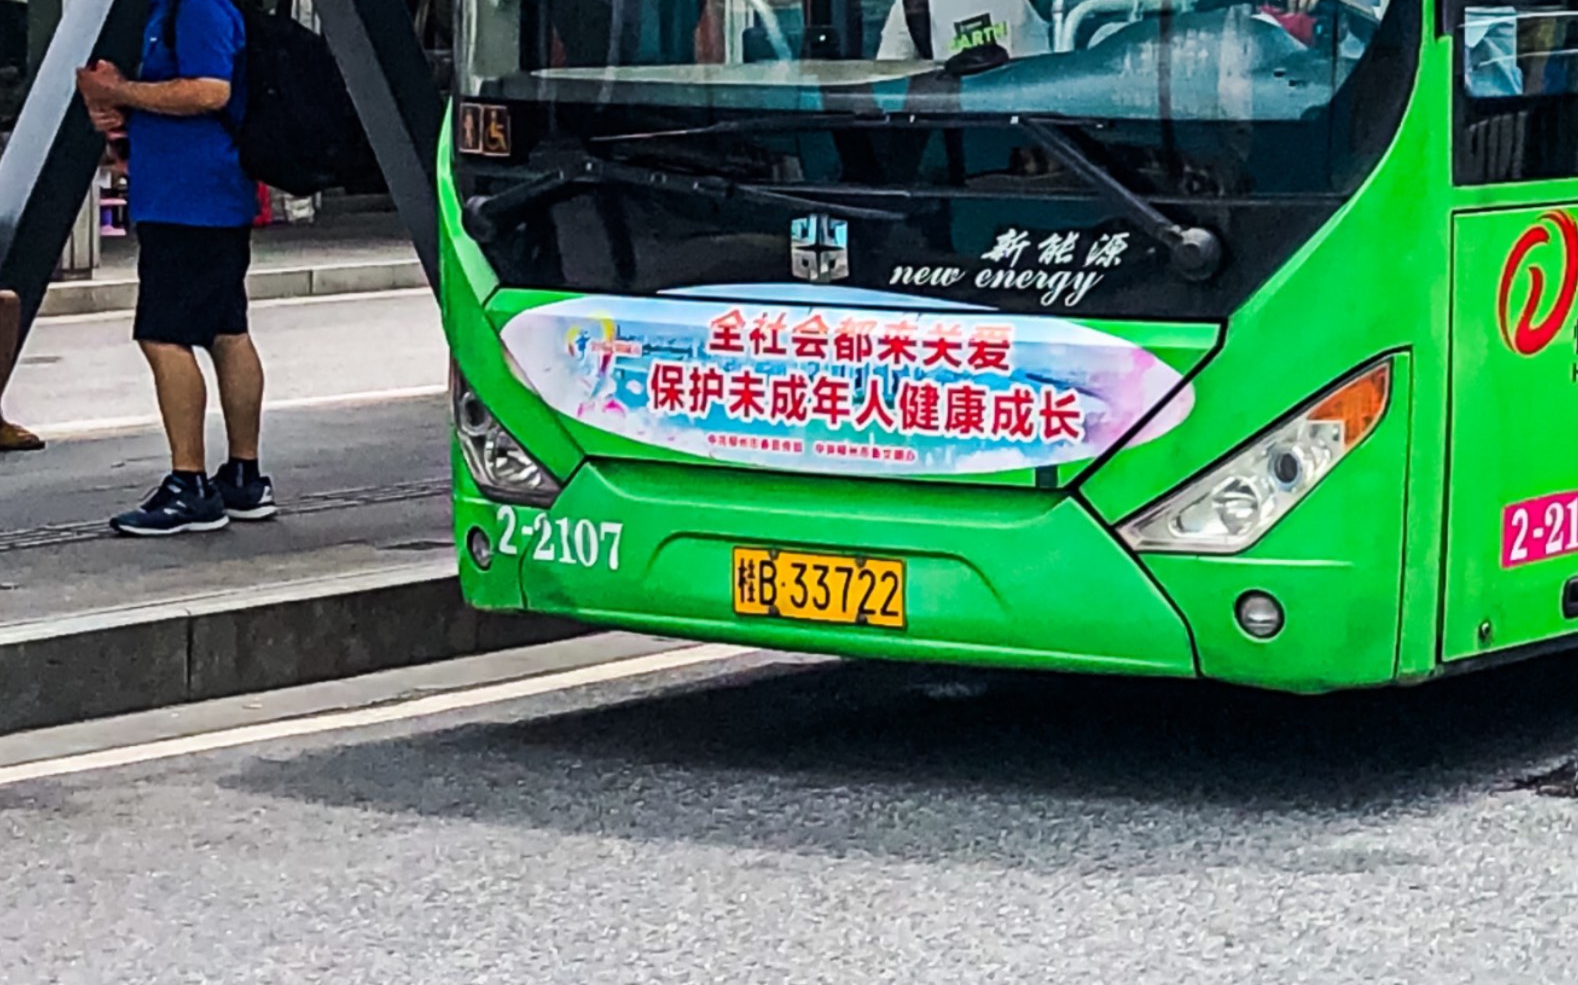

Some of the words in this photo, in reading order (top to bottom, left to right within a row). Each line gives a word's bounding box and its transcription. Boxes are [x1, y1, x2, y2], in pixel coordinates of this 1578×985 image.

[980, 228, 1131, 268] 新能源
[889, 265, 966, 287] new
[974, 267, 1105, 307] energy
[708, 308, 1013, 373] 全社会都来关爱
[649, 363, 1083, 441] 保护未成年人健康成长
[496, 504, 624, 571] 2-2107
